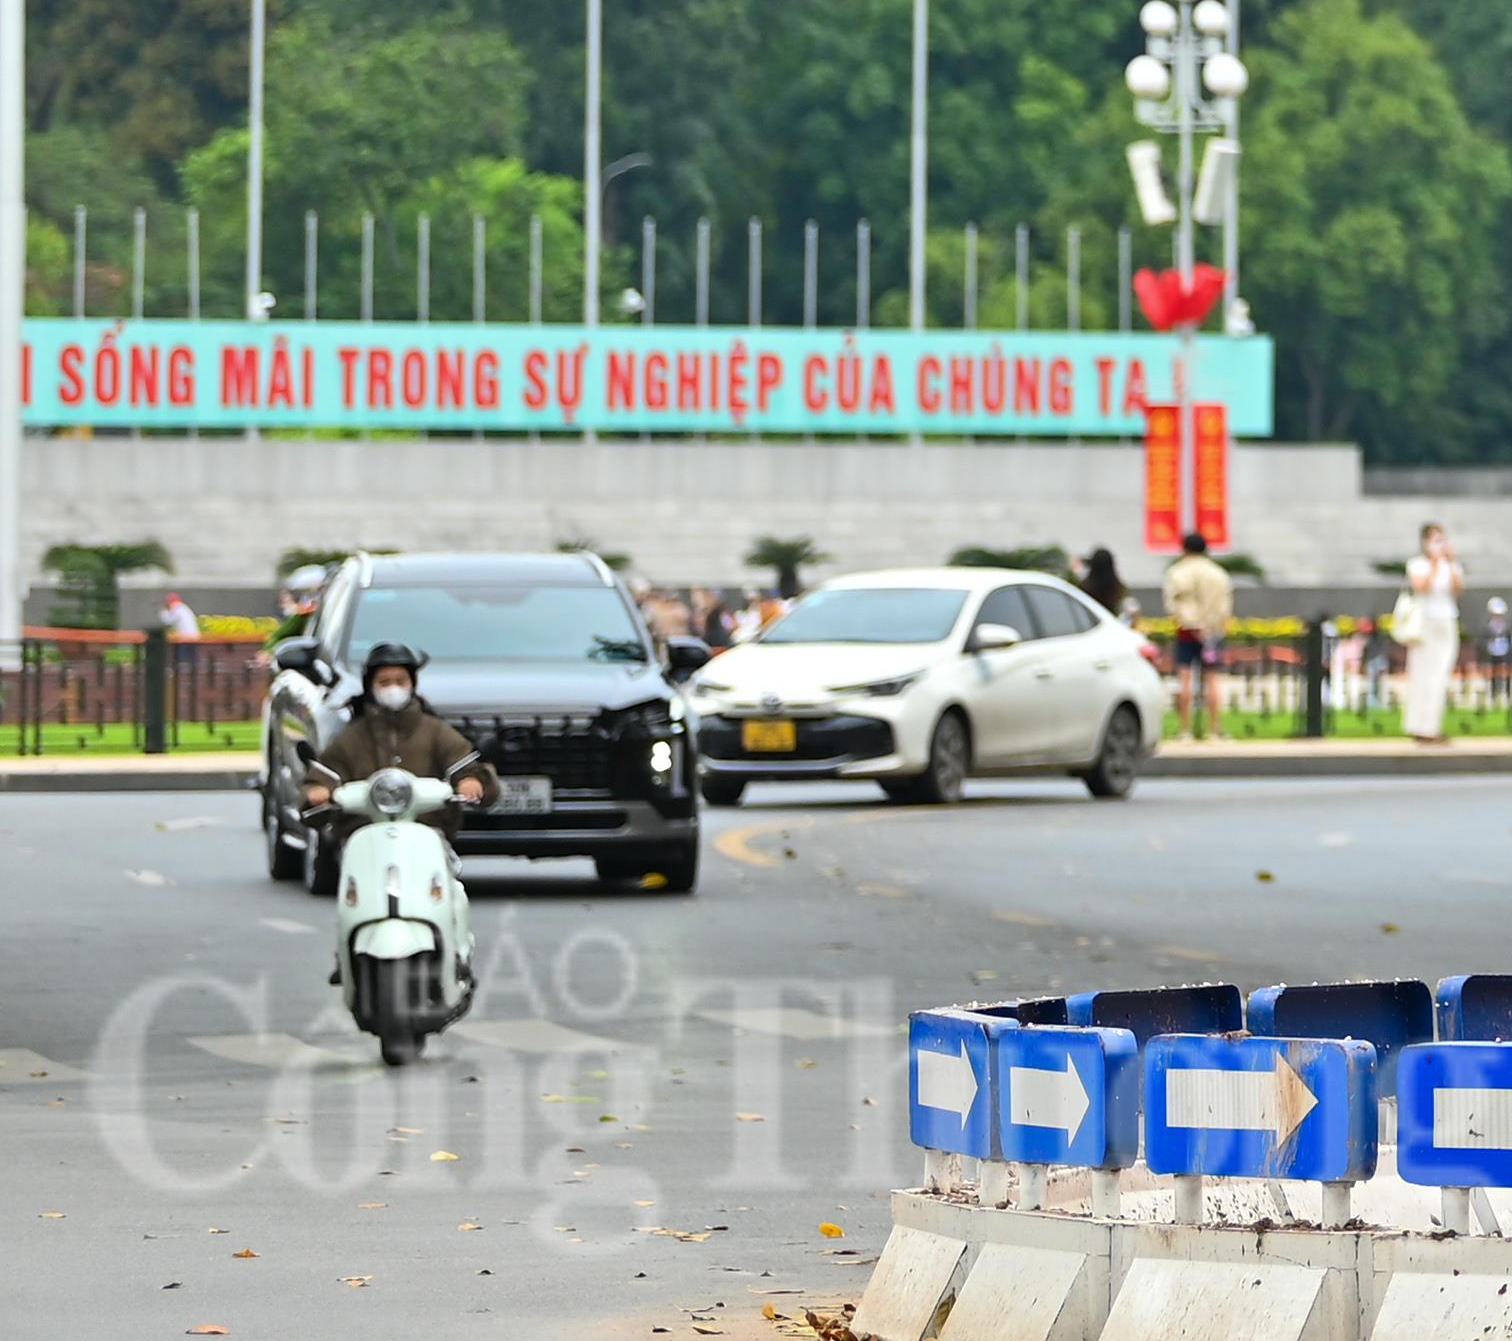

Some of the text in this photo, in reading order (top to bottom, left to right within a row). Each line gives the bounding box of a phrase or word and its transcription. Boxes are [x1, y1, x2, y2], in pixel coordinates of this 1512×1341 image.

[58, 320, 195, 408] SỐNG
[220, 334, 314, 409] MÃI
[337, 347, 500, 410] TRONG
[522, 341, 589, 424] SỰ
[606, 338, 783, 427] NGHIỆP
[803, 330, 894, 415] CỦA
[916, 344, 1075, 416] CHÚNG
[1094, 358, 1149, 414] TA
